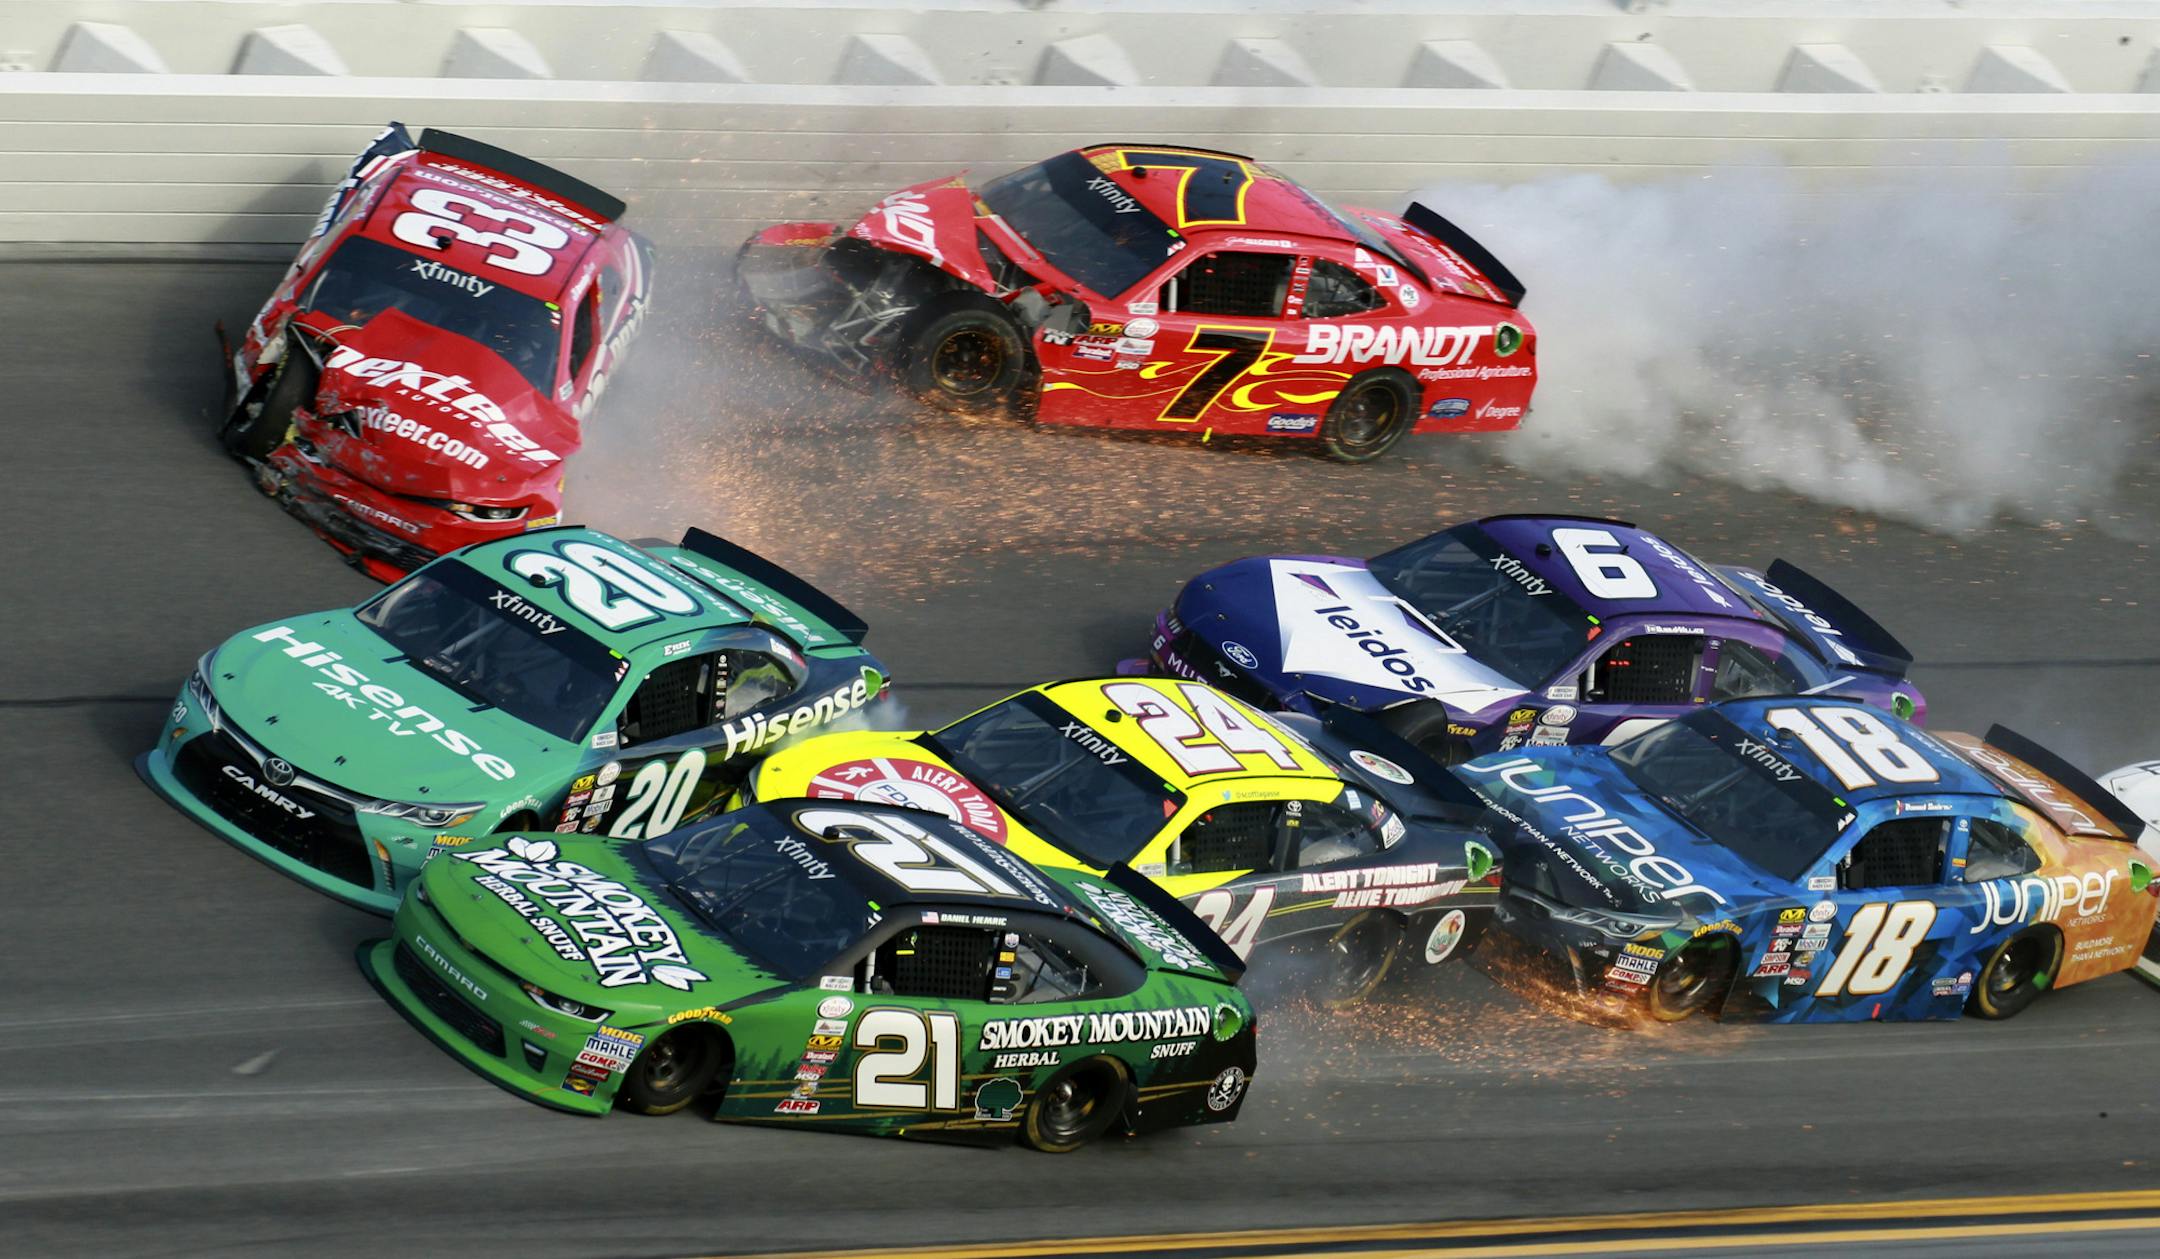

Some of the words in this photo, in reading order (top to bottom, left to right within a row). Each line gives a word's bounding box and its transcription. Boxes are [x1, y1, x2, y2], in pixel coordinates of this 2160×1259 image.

[1086, 176, 1140, 214] xfinity
[1116, 150, 1255, 229] 7
[392, 189, 569, 276] 33
[411, 259, 494, 297] xfinity
[1293, 323, 1494, 366] BRANDT
[1156, 324, 1276, 423] 7
[1418, 368, 1476, 381] Professional
[326, 345, 563, 462] nexteer
[1267, 416, 1318, 429] Goody's
[1486, 406, 1521, 418] Degree
[352, 404, 490, 471] exteer.com
[1489, 554, 1552, 598] xfinity
[1551, 528, 1658, 600] 6
[1641, 535, 1713, 589] leidos
[504, 540, 704, 633] 20
[1738, 570, 1843, 638] leidos
[489, 591, 566, 635] xfinity
[1153, 635, 1166, 650] 6
[1314, 604, 1436, 694] leidos
[174, 701, 189, 724] 20
[252, 626, 515, 781] Hisense
[312, 682, 367, 710] 4K
[369, 713, 416, 737] TV
[722, 677, 868, 762] Hisense
[1059, 721, 1128, 767] xfinity
[1100, 682, 1304, 777] 24
[1447, 723, 1478, 737] YEAR
[1765, 706, 1940, 791] 18
[912, 765, 969, 794] ALERT
[1735, 738, 1802, 783] xfinity
[221, 765, 316, 819] CAMRY
[608, 748, 707, 841] 20
[877, 785, 934, 813] FDO
[774, 836, 835, 882] xfinity
[791, 808, 1032, 901] 21
[1493, 804, 1522, 824] MORE
[1520, 820, 1550, 843] THAN
[1545, 840, 1556, 849] A
[1552, 847, 1604, 889] NETWORK
[1560, 825, 1661, 905] NETWORKS
[1302, 869, 1360, 893] ALERT
[1360, 863, 1439, 888] TONIGHT
[1331, 889, 1385, 908] ALIVE
[453, 847, 648, 988] MOUNTAIN
[475, 875, 534, 919] HERBAL
[531, 916, 585, 963] SNUFF
[536, 861, 688, 966] SMOKEY
[941, 913, 970, 923] DANIEL
[972, 915, 1007, 926] HEMRIC
[1693, 919, 1744, 938] GOODYEAR
[416, 935, 488, 1001] CAMARO
[1618, 956, 1657, 972] MAHLE
[1624, 943, 1665, 959] MOOG
[1757, 964, 1789, 975] ARP
[1815, 900, 1937, 998] 18
[1612, 968, 1640, 981] COMP
[599, 1025, 645, 1045] MOOG
[668, 1006, 733, 1025] GOODYEAR
[980, 1014, 1085, 1050] SMOKEY
[1088, 1006, 1211, 1044] MOUNTAIN
[580, 1052, 617, 1070] COMP
[587, 1038, 637, 1060] MAHLE
[852, 1006, 963, 1113] 21
[994, 1052, 1060, 1069] HERBAL
[1151, 1042, 1196, 1060] SNUFF
[778, 1101, 818, 1111] ARP
